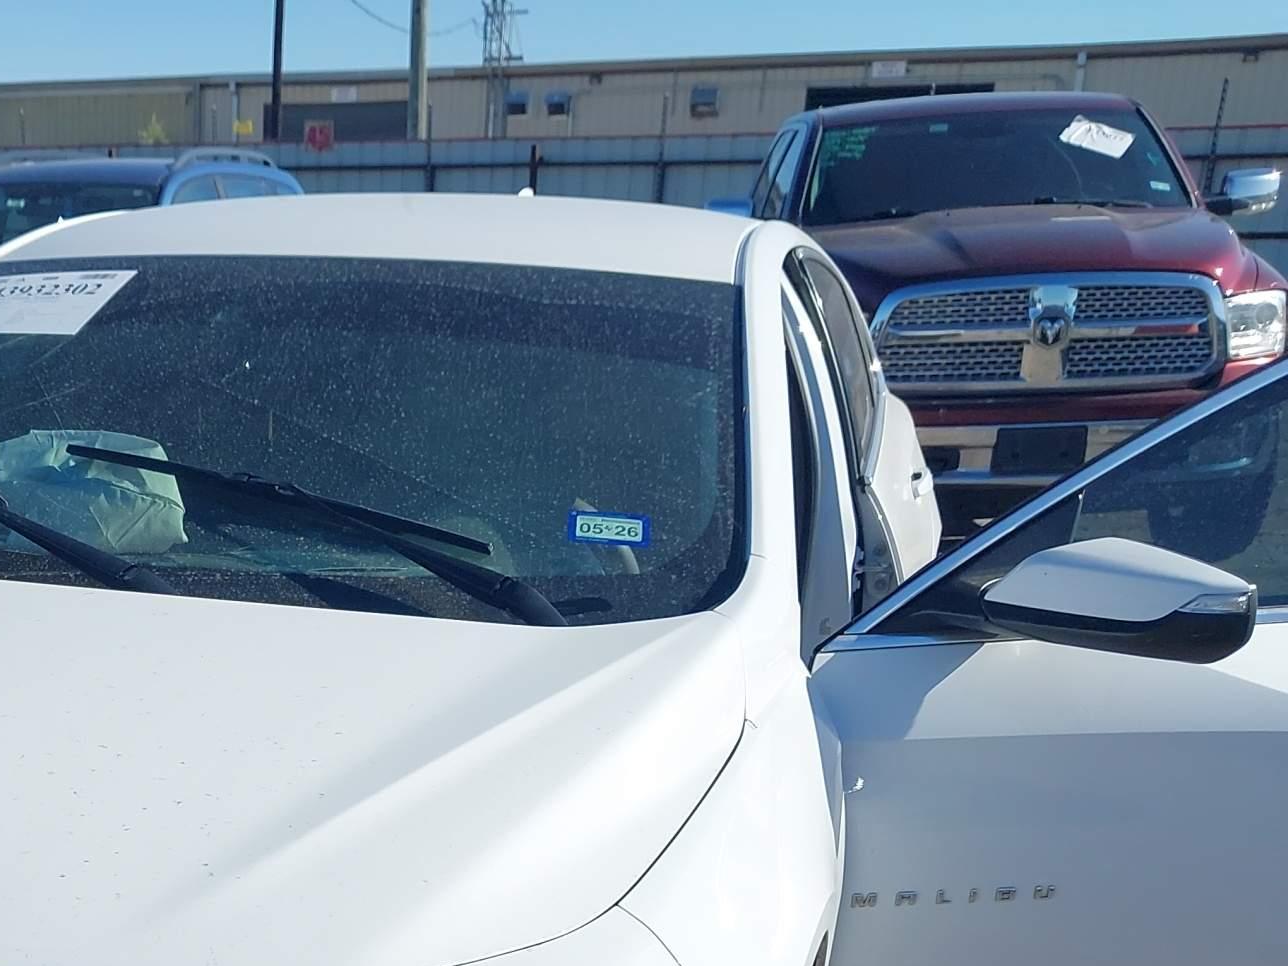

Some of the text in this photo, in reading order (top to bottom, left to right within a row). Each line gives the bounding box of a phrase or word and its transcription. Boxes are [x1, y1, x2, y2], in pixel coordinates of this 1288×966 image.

[579, 522, 639, 538] 05 26
[850, 884, 1056, 908] MALIBU
